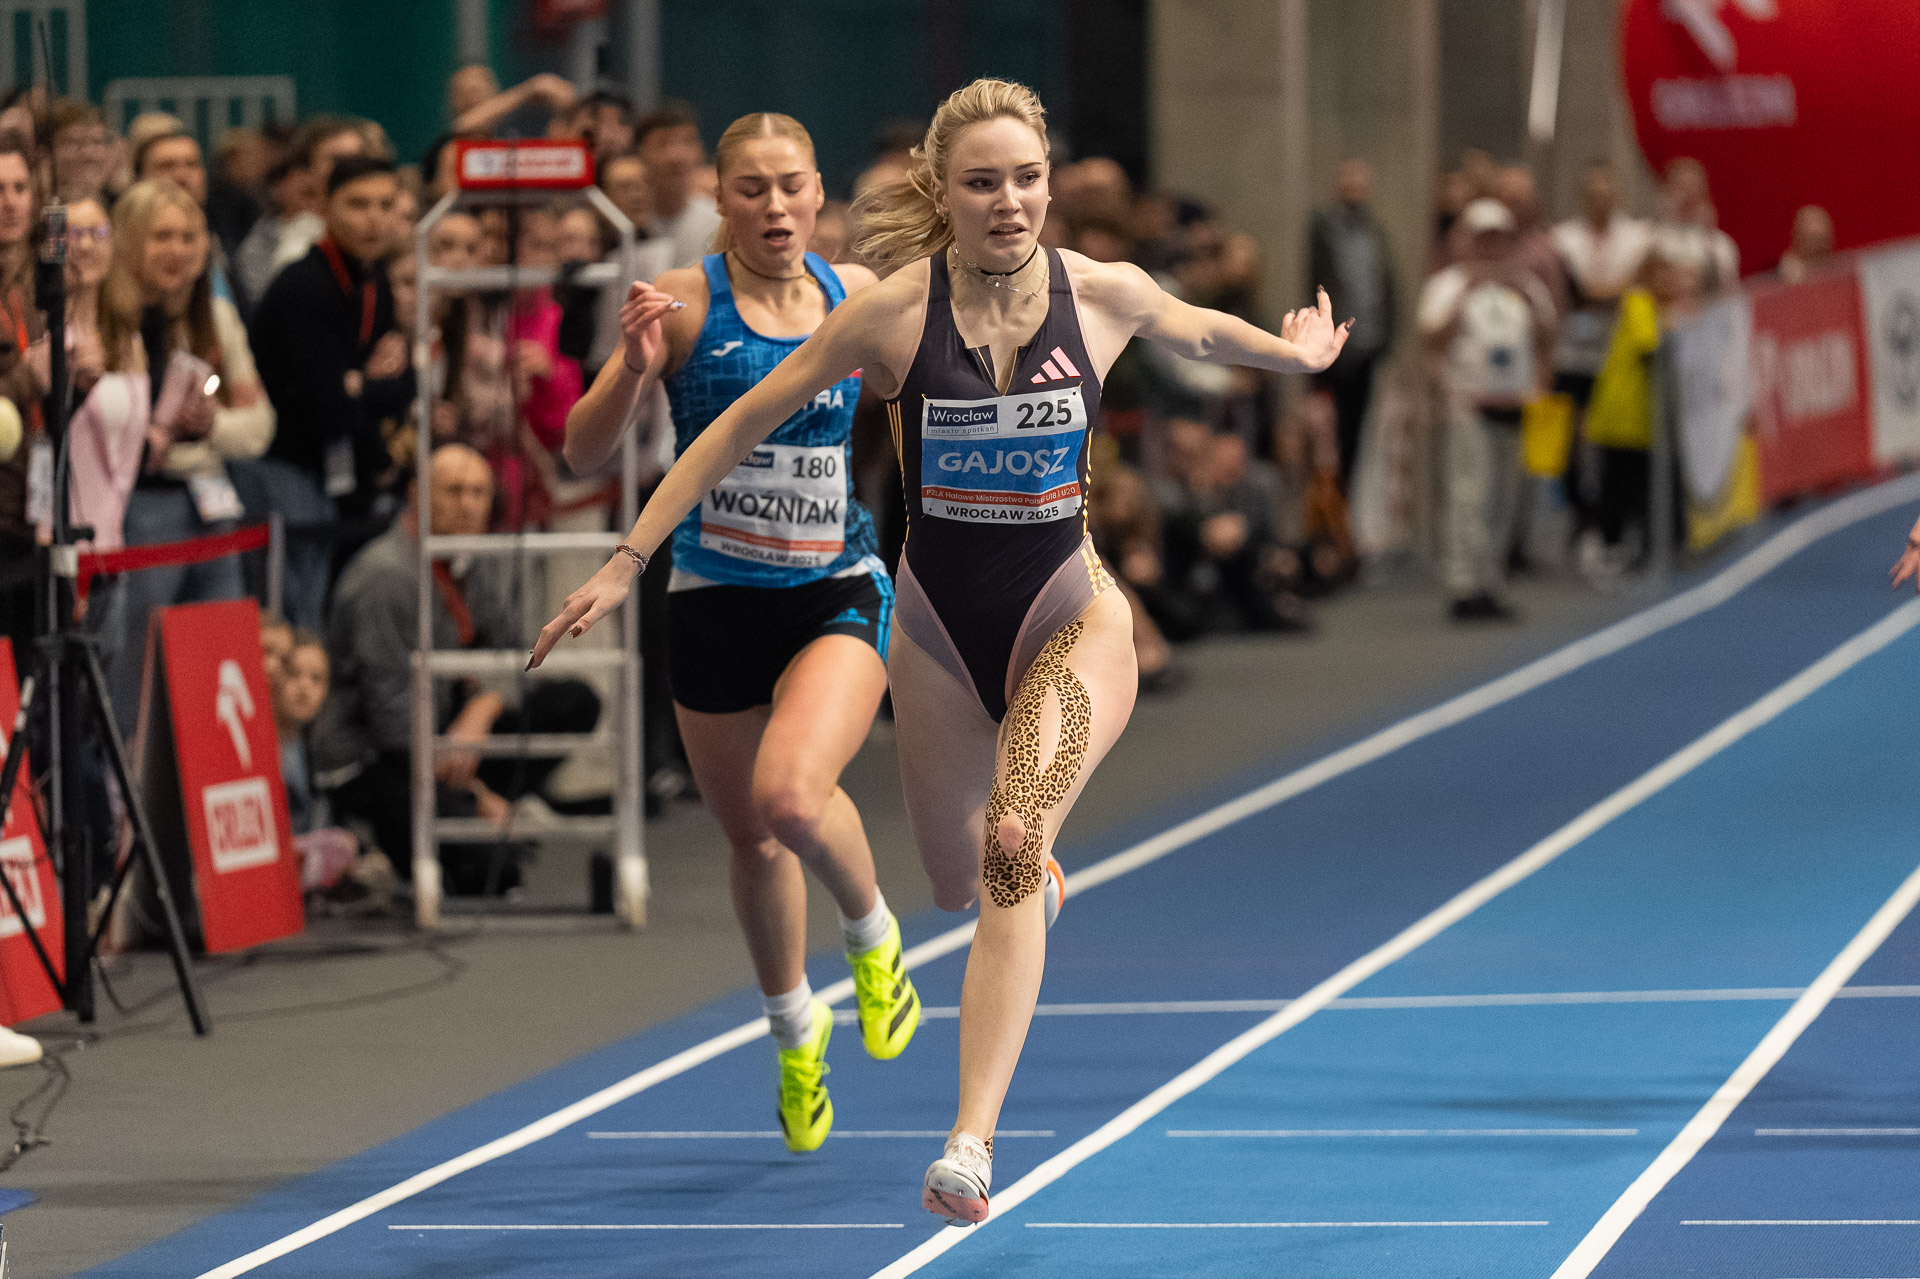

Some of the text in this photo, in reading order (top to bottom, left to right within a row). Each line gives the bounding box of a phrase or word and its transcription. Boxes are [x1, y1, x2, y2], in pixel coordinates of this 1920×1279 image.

[932, 398, 1072, 430] Wrocław 225
[962, 426, 995, 435] spotkań
[792, 456, 836, 478] 180
[938, 446, 1070, 478] GAJOSZ
[926, 489, 944, 497] PZLA
[945, 491, 974, 501] Halowe
[975, 494, 1023, 503] Mistrzostwa
[1045, 492, 1057, 501] U18
[1061, 486, 1076, 496] U20
[711, 488, 839, 525] WOŹNIAK
[946, 505, 1059, 520] WROCŁAW 2025
[720, 540, 789, 563] WROCŁAW
